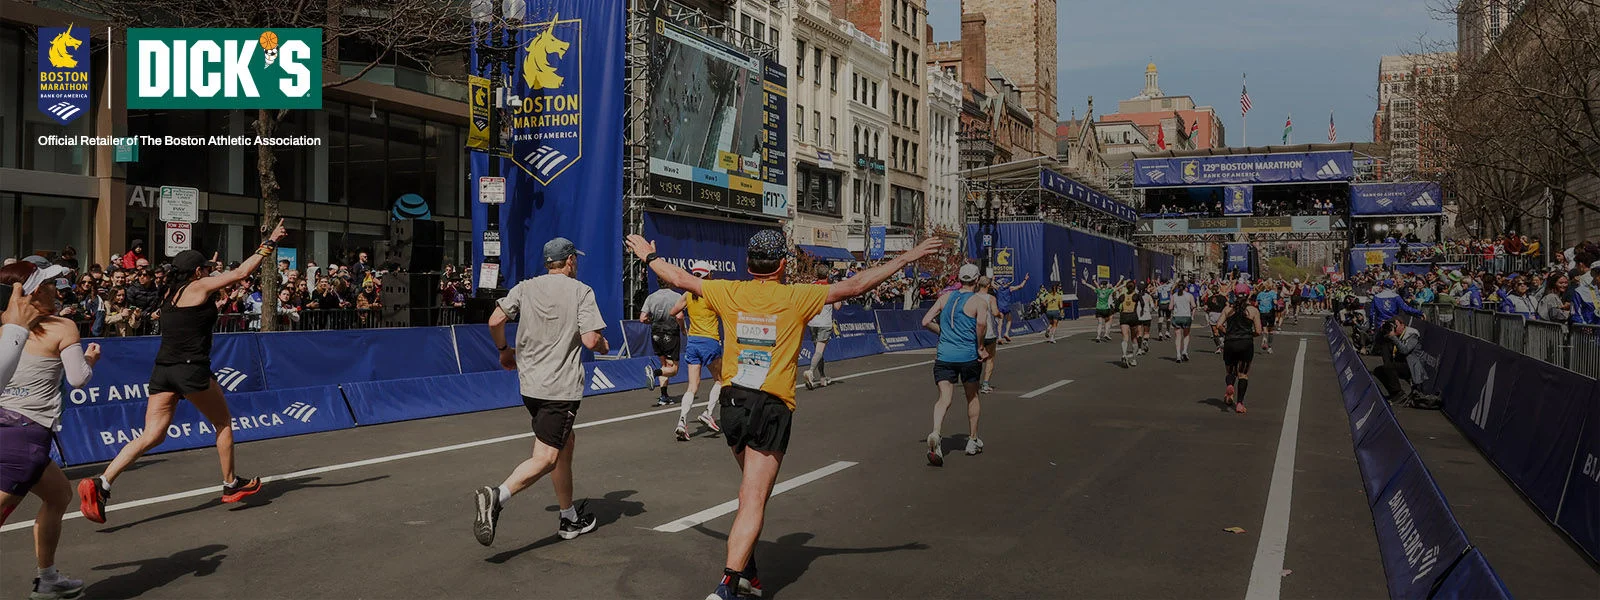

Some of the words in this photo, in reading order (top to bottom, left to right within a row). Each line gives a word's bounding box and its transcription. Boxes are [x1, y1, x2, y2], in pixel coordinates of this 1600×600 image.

[513, 113, 580, 129] MARATHON
[514, 133, 533, 142] BANK
[543, 131, 578, 140] AMERICA
[1221, 161, 1254, 172] BOSTON
[1255, 159, 1303, 171] MARATHON
[709, 261, 737, 273] ERICA
[69, 387, 100, 404] OF
[100, 427, 144, 445] BAN
[166, 423, 192, 439] OF
